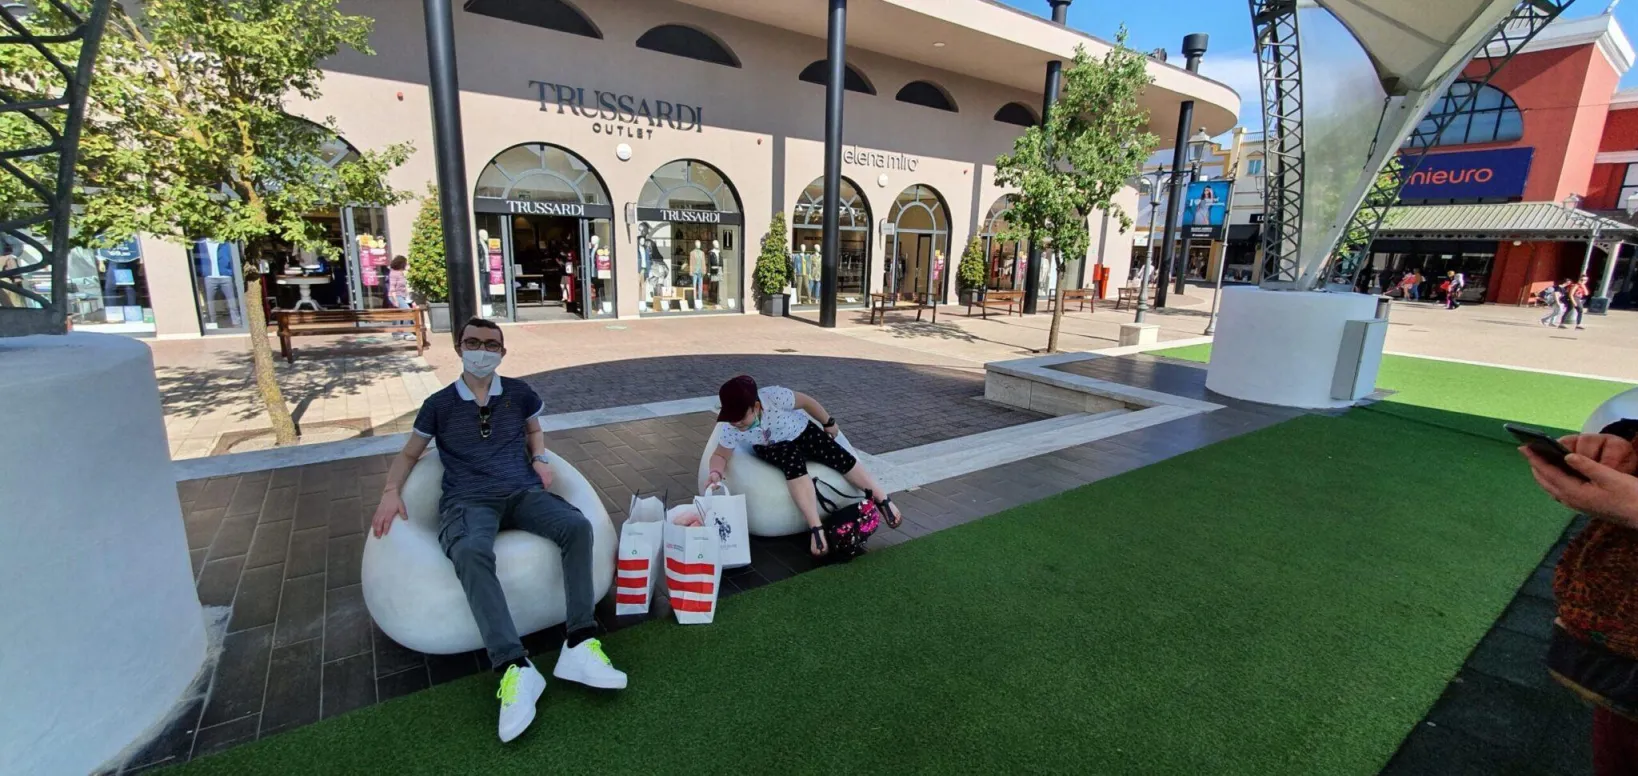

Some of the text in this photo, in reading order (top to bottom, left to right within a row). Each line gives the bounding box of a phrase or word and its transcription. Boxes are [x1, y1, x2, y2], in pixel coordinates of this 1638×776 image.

[528, 80, 703, 133] TRUSSARDI
[592, 123, 653, 140] OUTLET
[843, 146, 884, 168] elena
[1388, 167, 1492, 185] nieuro
[507, 200, 584, 216] TRUSSARDI
[660, 210, 720, 223] TRUSSARDI
